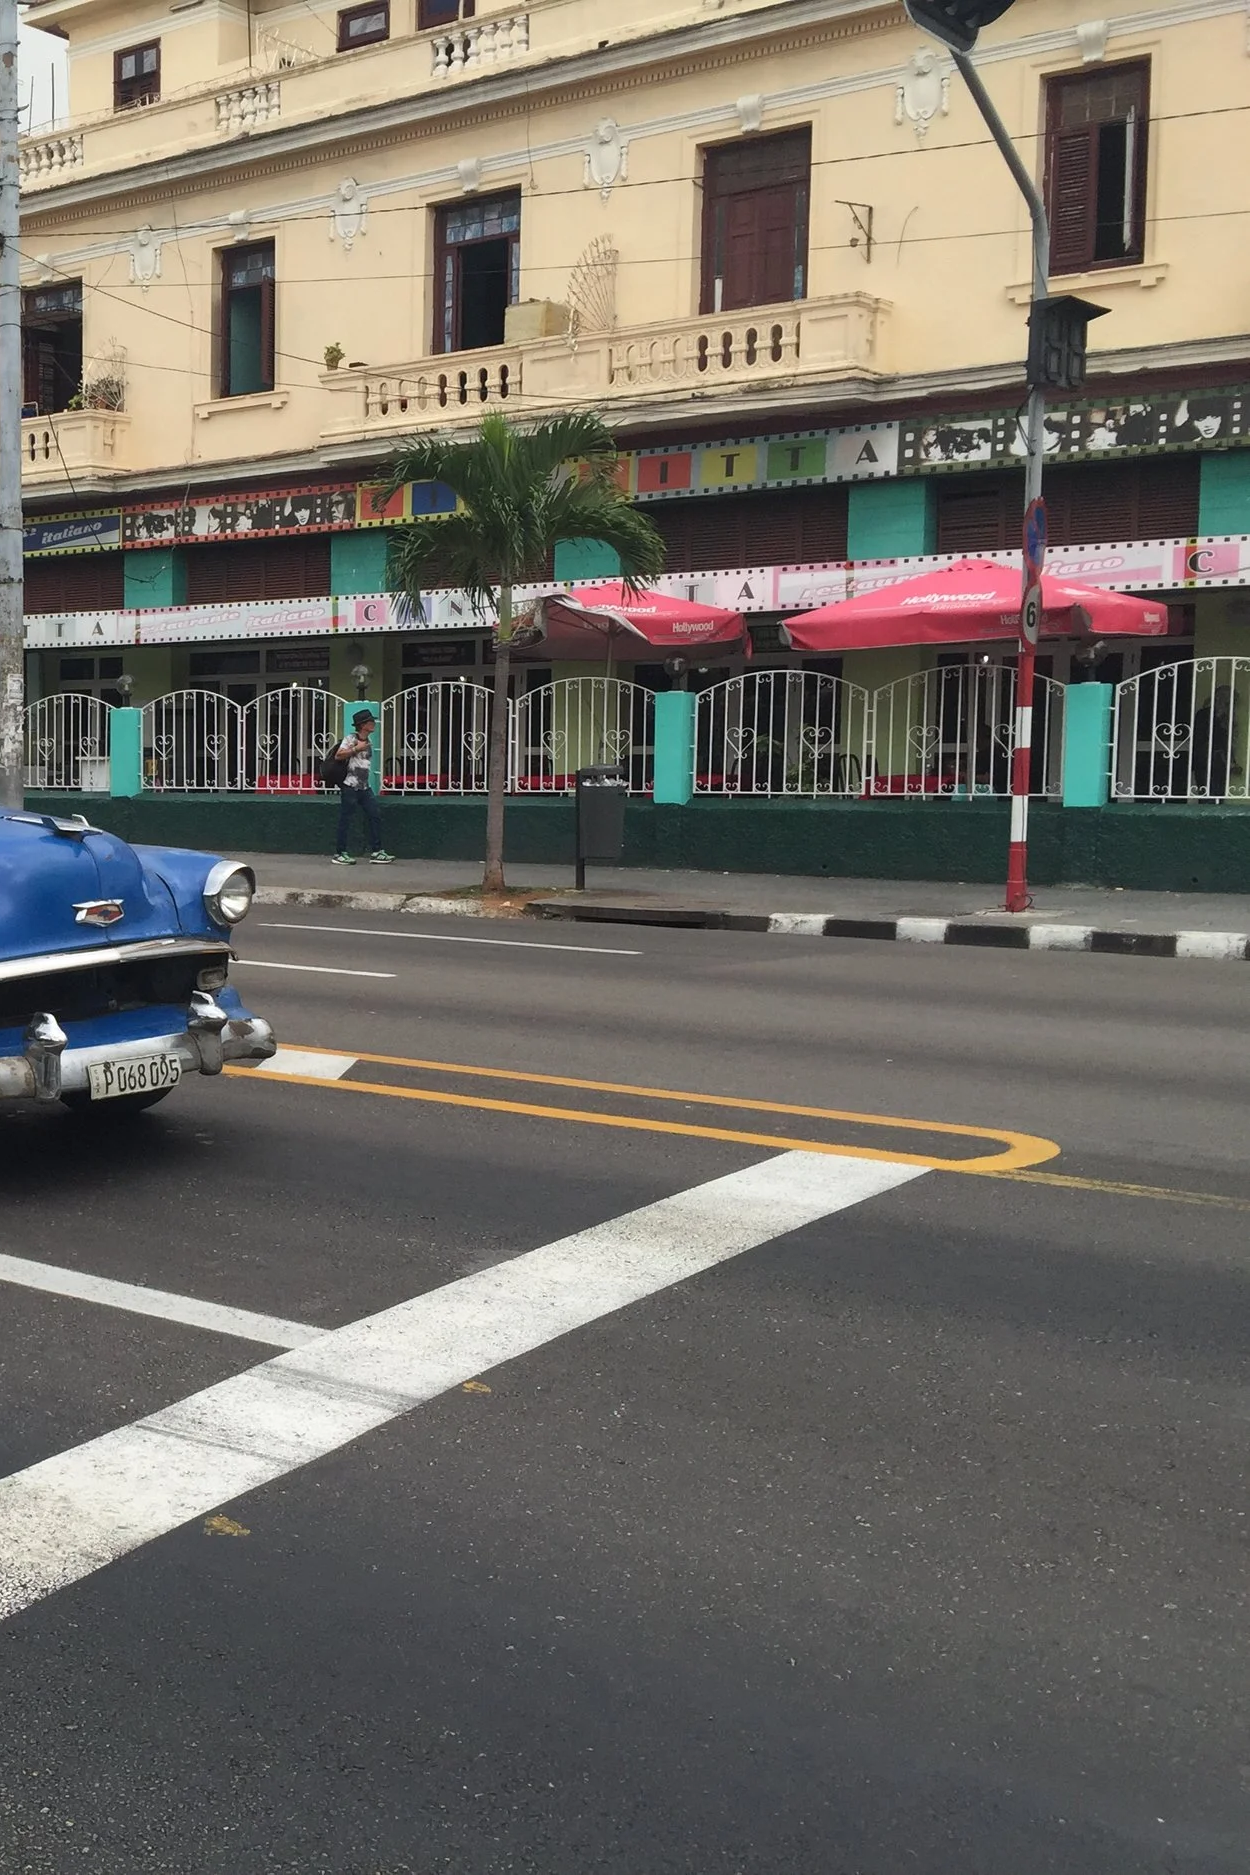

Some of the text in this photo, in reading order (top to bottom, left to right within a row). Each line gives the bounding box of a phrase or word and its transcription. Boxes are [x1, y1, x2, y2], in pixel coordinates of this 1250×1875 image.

[42, 522, 102, 544] italiano
[901, 591, 996, 606] Hollywood
[246, 608, 325, 628] italiano
[1026, 601, 1036, 628] 6
[672, 620, 714, 635] Hollywood
